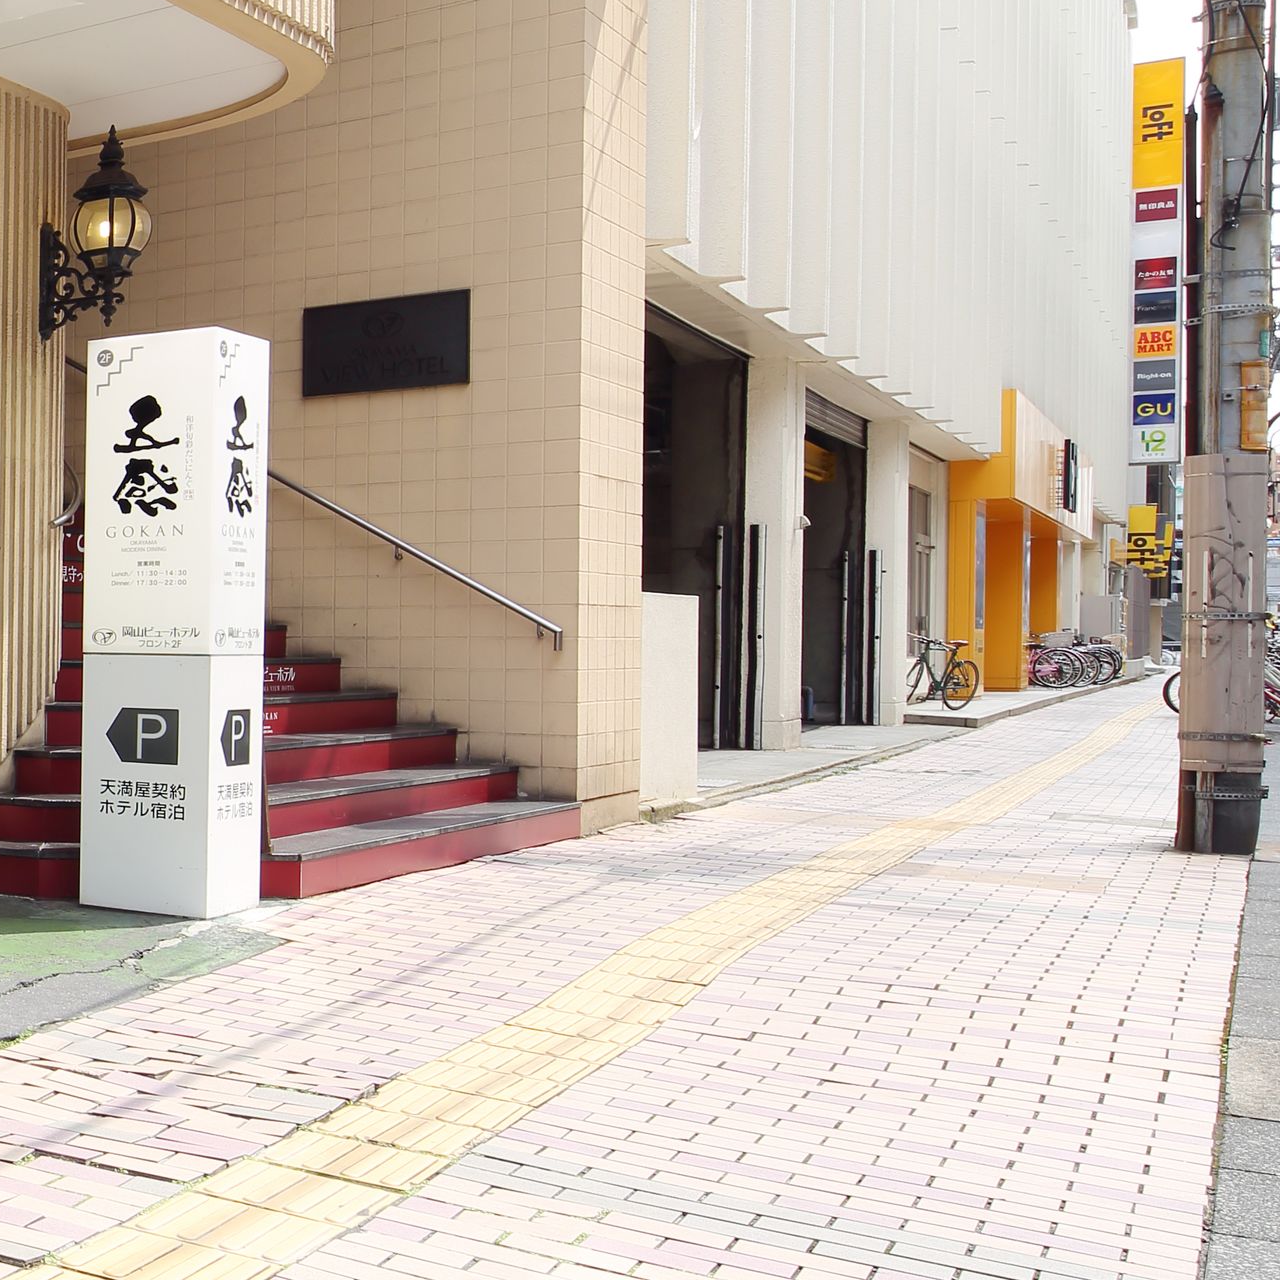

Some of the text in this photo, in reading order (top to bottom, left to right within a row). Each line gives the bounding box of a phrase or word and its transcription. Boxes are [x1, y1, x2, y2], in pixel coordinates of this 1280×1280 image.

[1139, 200, 1175, 211] 無印良品
[1137, 330, 1173, 344] ABC
[1137, 343, 1173, 354] MART
[99, 353, 112, 365] 2F
[1137, 402, 1172, 417] GU
[105, 524, 184, 539] GOKAN
[122, 626, 201, 638] 岡山ビューホテル
[136, 713, 167, 759] P
[231, 714, 245, 761] P
[100, 778, 186, 801] 天満屋契約
[99, 800, 186, 821] ホテル宿泊
